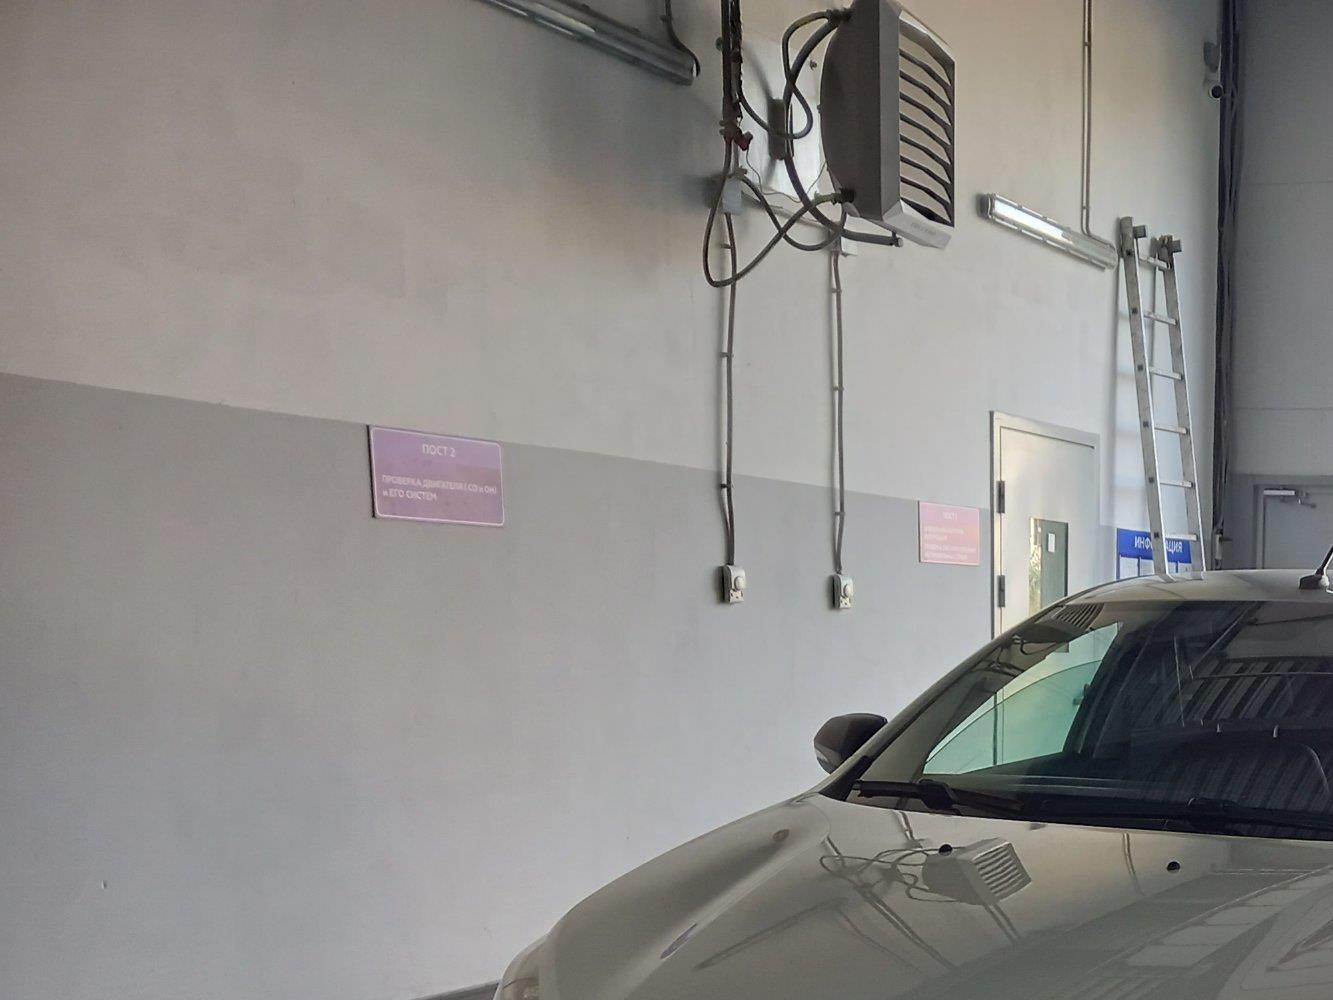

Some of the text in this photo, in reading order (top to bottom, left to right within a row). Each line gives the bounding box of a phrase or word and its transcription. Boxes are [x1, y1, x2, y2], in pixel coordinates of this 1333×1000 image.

[422, 443, 456, 458] ПОСТ 2
[1134, 535, 1183, 554] ИНФАЦИЯ
